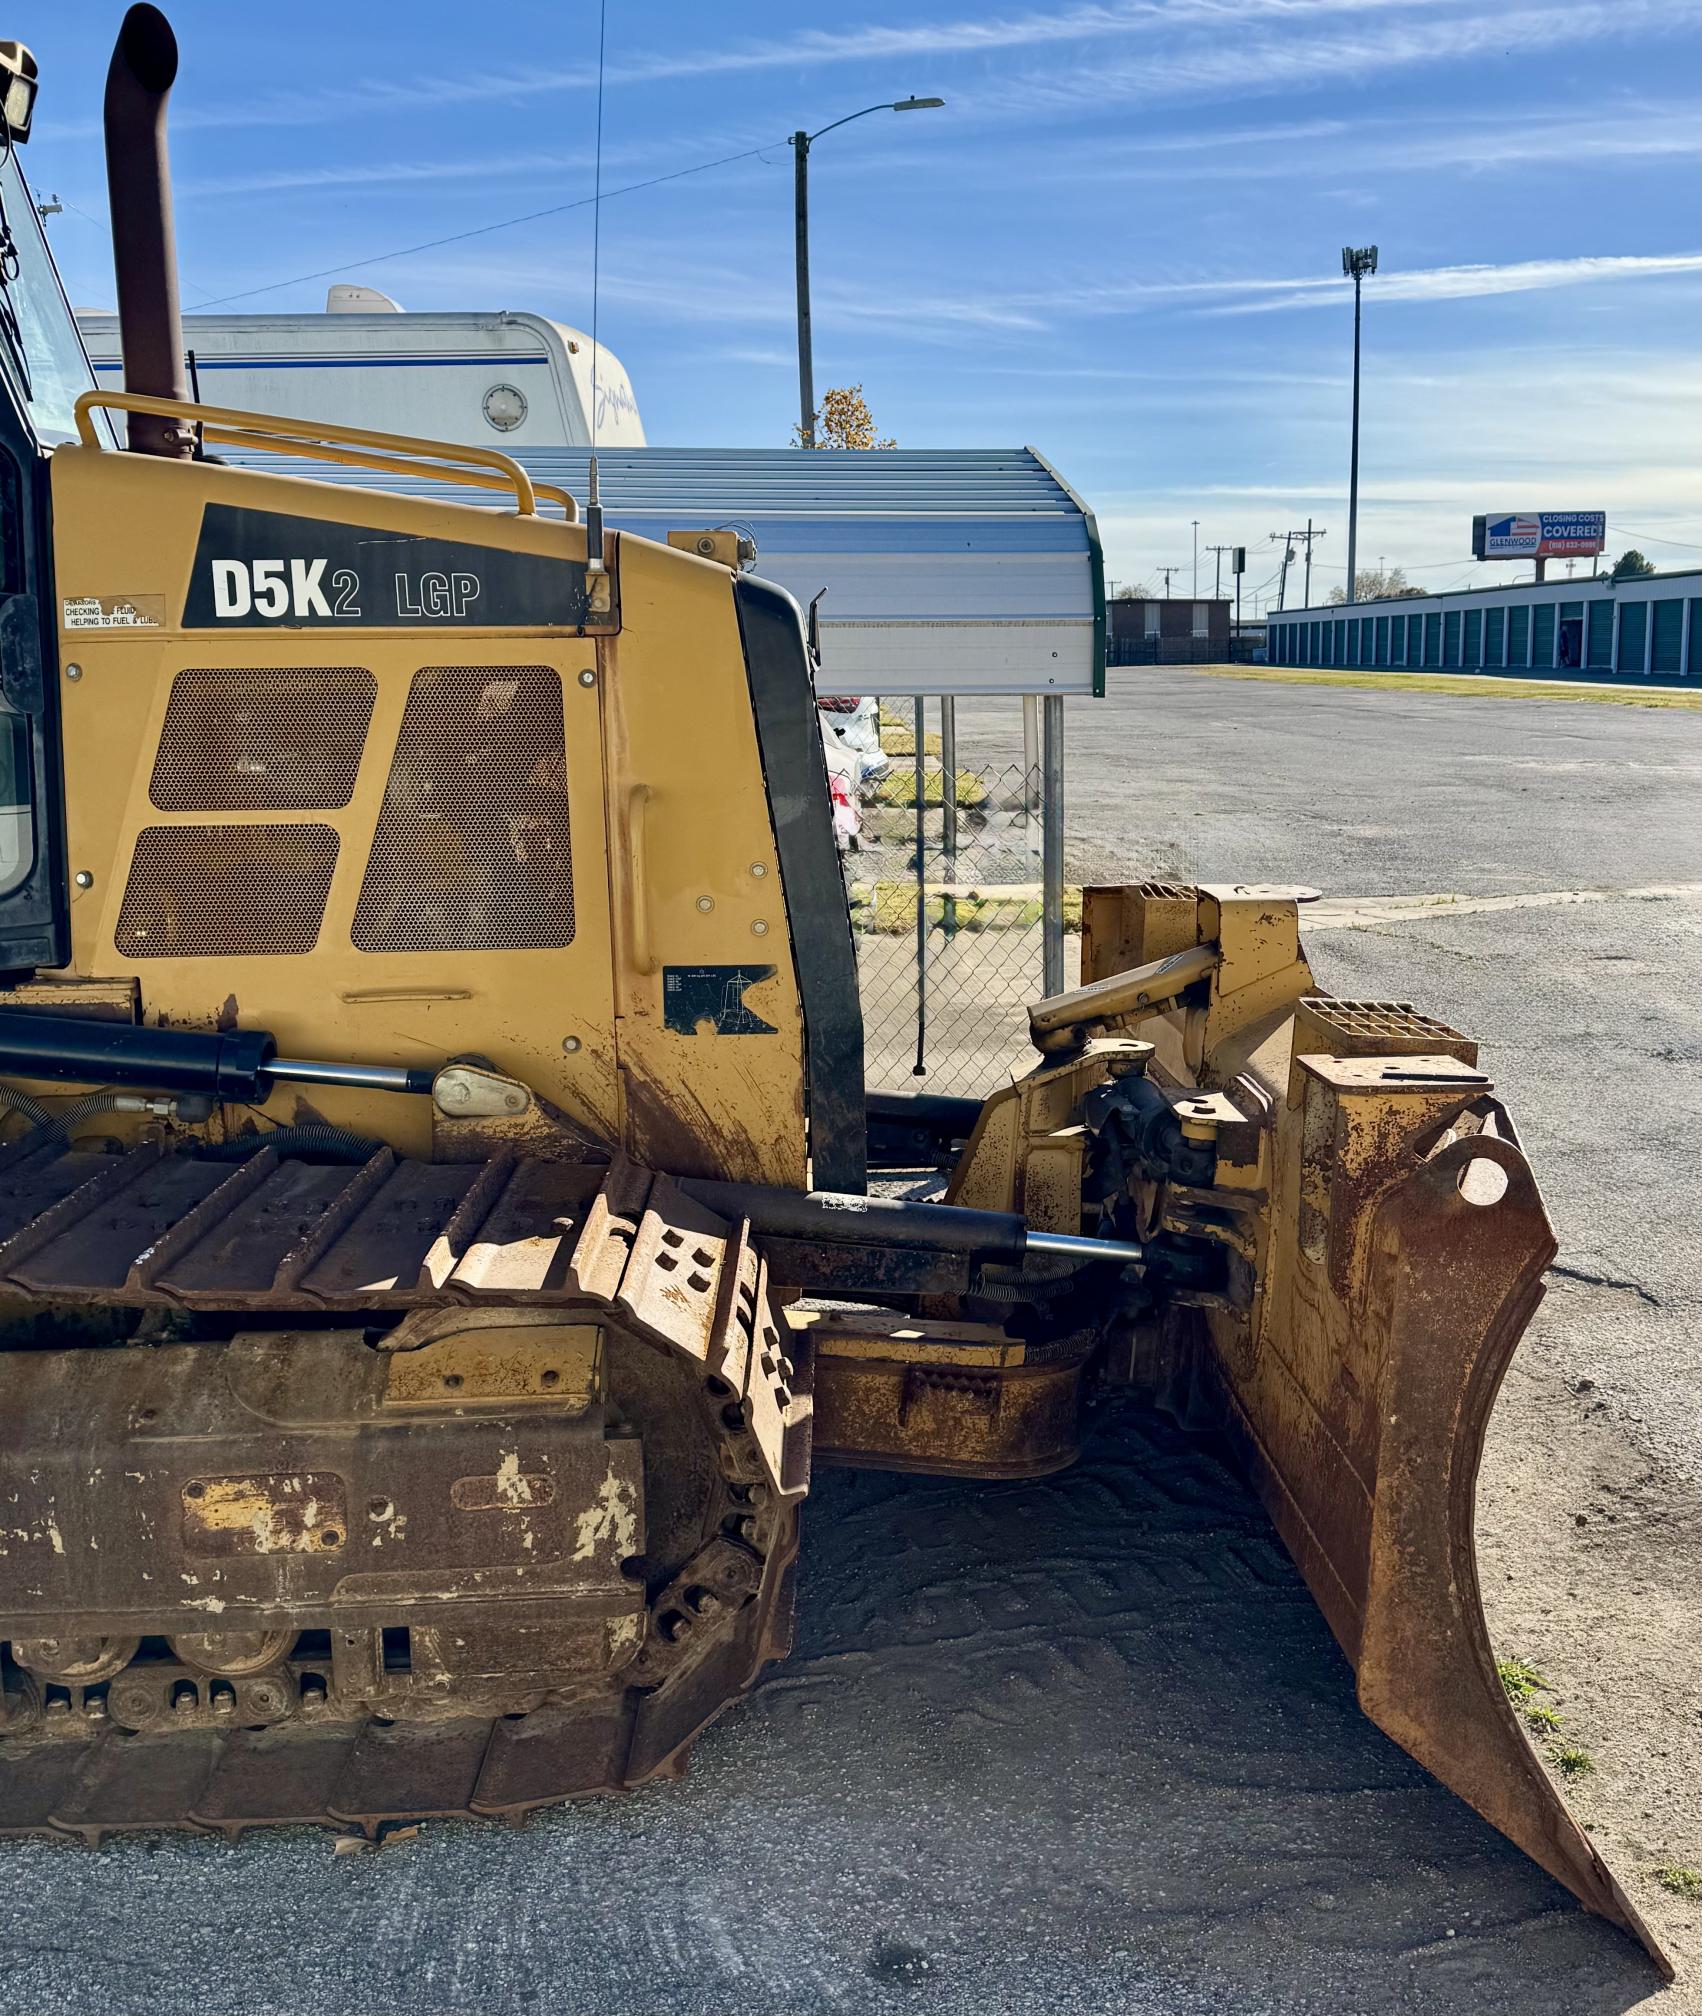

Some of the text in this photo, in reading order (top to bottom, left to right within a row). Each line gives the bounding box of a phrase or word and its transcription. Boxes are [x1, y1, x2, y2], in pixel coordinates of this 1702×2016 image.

[1543, 513, 1604, 523] CLOSING COSTS
[1543, 525, 1603, 538] COVERED!
[1490, 537, 1537, 546] GLENWOOD
[395, 572, 480, 617] LGP
[65, 607, 100, 615] CHECKING
[71, 617, 99, 626] HELPING
[101, 617, 110, 625] TO
[113, 617, 130, 625] FUEL
